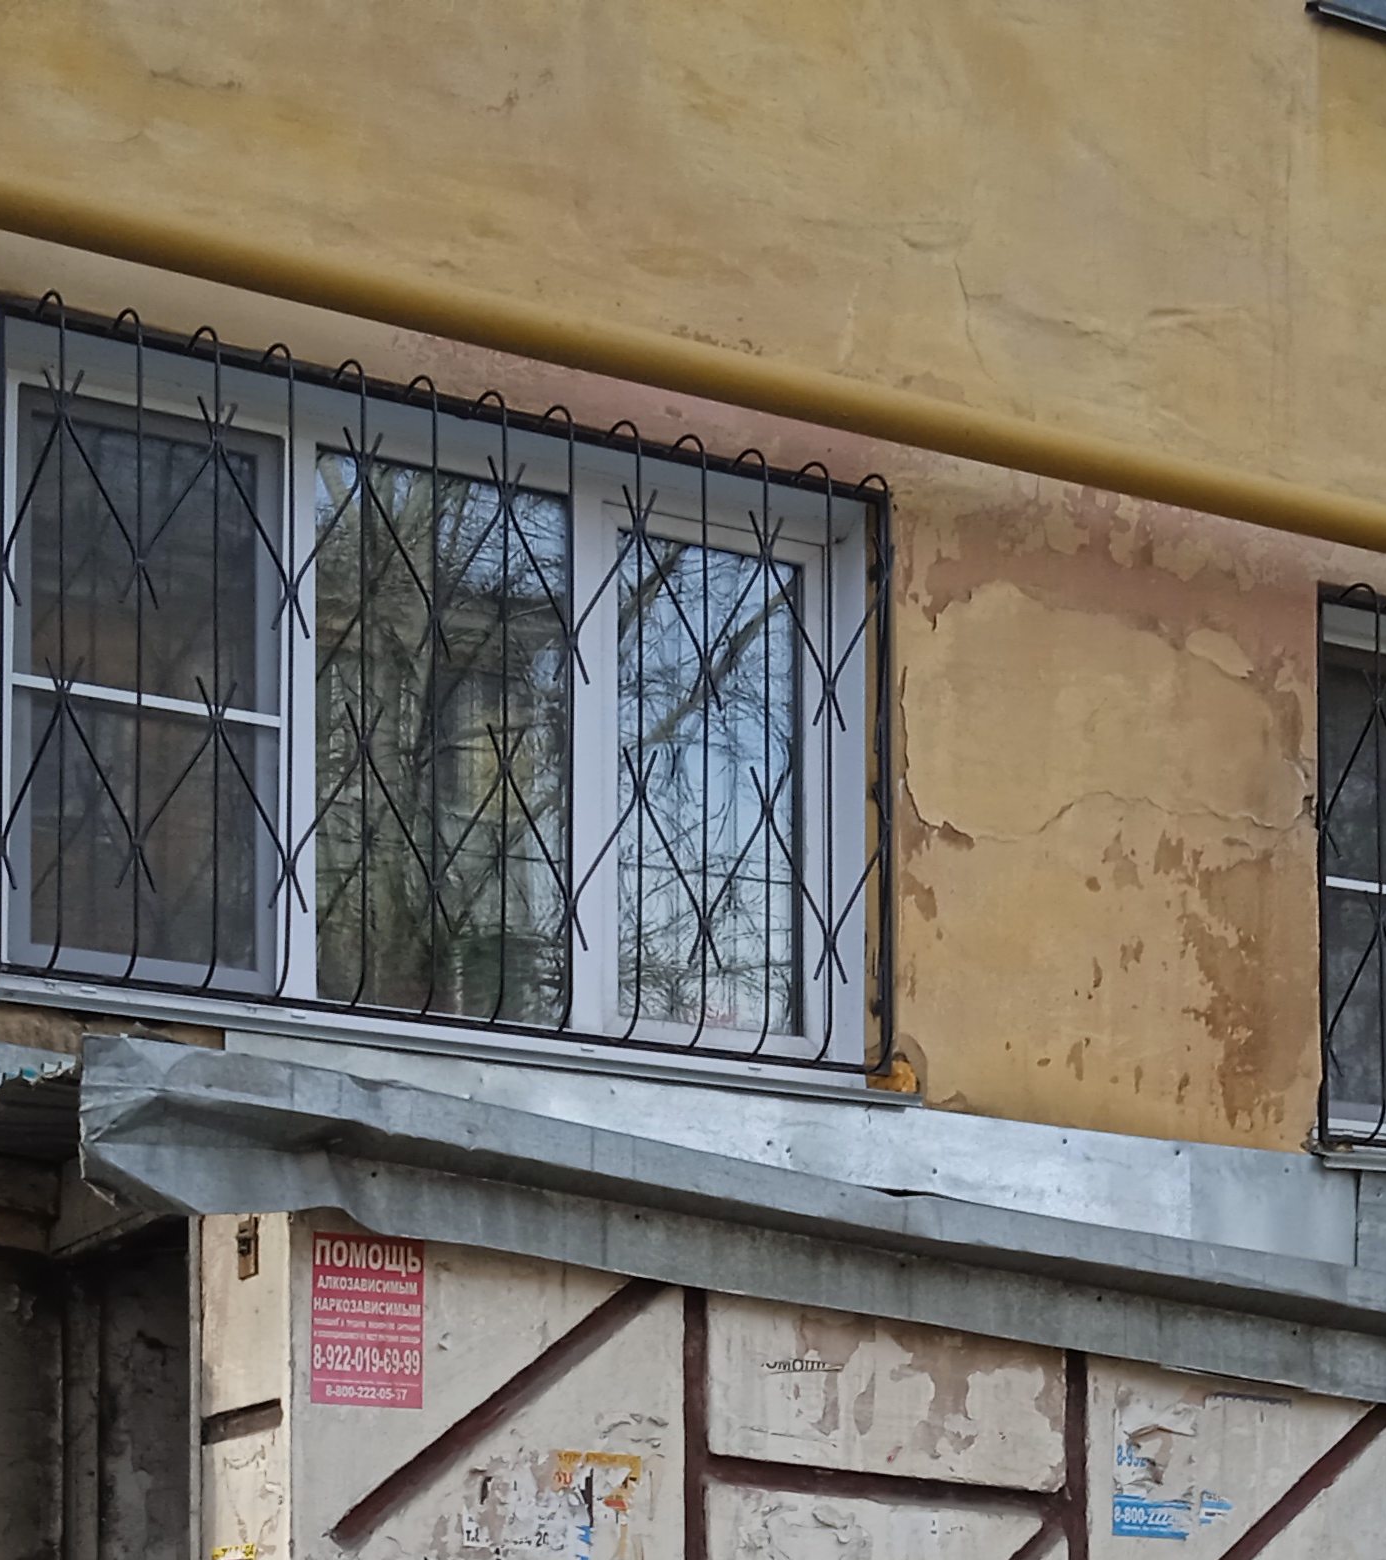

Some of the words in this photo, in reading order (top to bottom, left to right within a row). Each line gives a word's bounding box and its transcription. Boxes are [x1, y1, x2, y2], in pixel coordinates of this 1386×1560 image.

[315, 1239, 422, 1277] ПОМОЩЬ
[316, 1274, 419, 1296] АЛКОЗАВИСИМЫМ
[313, 1296, 422, 1316] НАРКОЗАВИСИМЫМ
